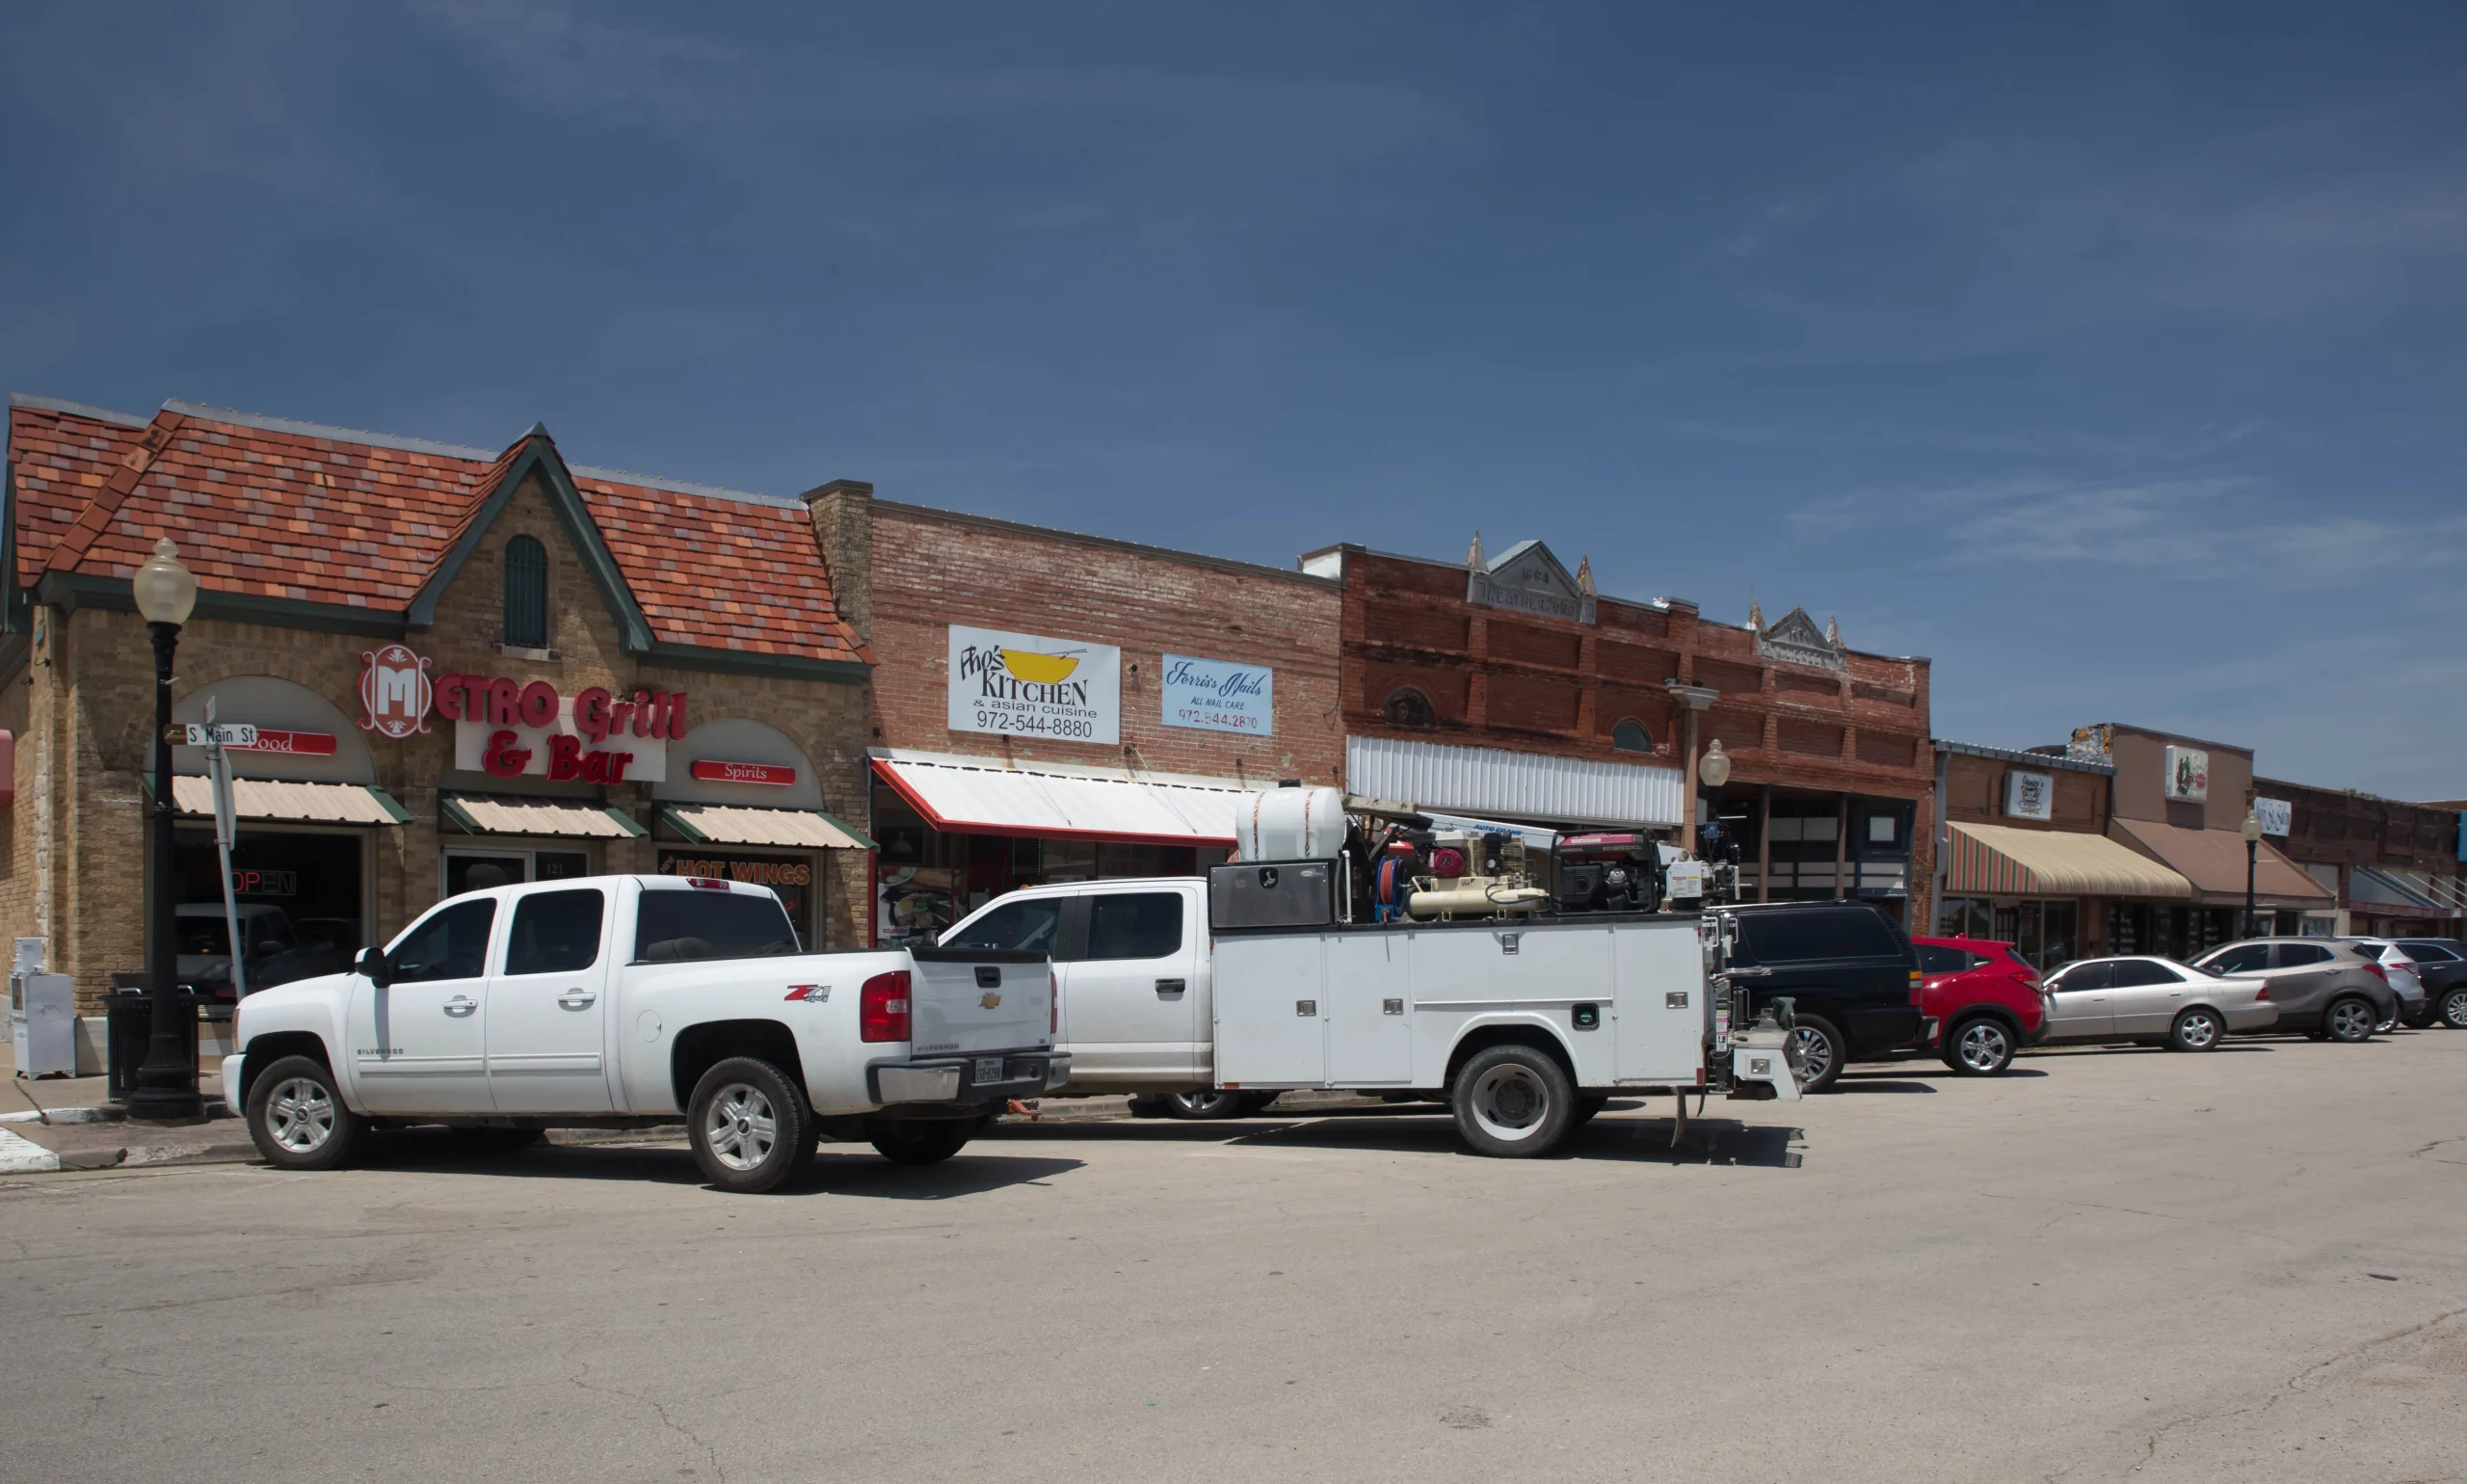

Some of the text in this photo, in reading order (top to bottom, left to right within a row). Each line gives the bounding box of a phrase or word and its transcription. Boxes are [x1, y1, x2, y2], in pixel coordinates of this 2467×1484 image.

[960, 644, 1006, 681] Pho's
[981, 669, 1088, 707] KITCHEN
[1218, 673, 1268, 698] Nails
[973, 699, 1098, 719] & asian cuisine
[1191, 697, 1245, 710] ALL NAIL CARE
[572, 686, 688, 744] Grill
[977, 710, 1093, 738] 972-544-8880
[189, 727, 198, 743] S
[205, 727, 233, 743] Main
[241, 728, 255, 743] St
[249, 733, 294, 752] ood
[483, 729, 633, 785] & Bar
[725, 763, 767, 781] Spirits
[546, 863, 563, 875] 121
[676, 859, 810, 886] HOT WINGS
[231, 871, 293, 893] OPEN
[783, 984, 832, 1001] Z71
